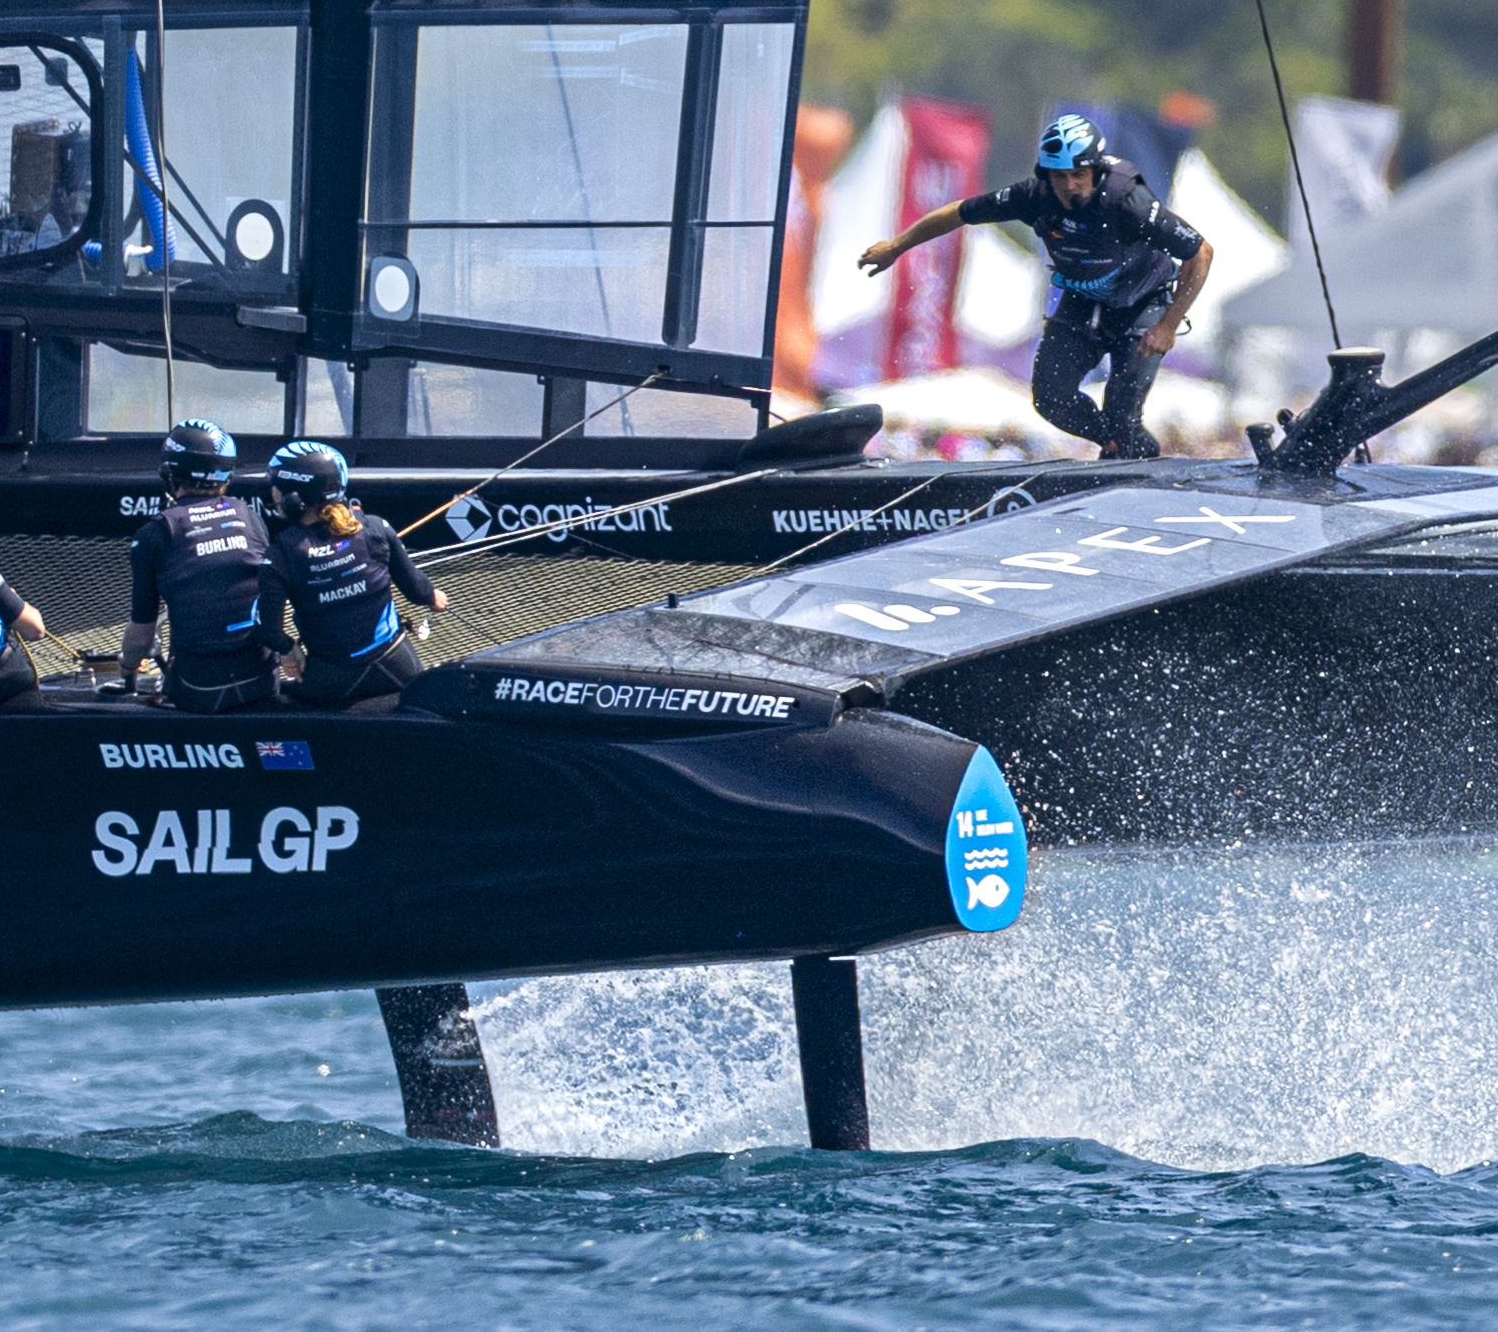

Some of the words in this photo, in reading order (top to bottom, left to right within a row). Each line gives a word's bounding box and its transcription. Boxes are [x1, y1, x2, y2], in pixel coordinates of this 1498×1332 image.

[497, 496, 673, 543] cognizant
[195, 535, 249, 557] BURLING
[308, 544, 336, 558] NZL
[928, 506, 1298, 606] APEX
[319, 580, 367, 604] MACKAY
[495, 677, 794, 719] #RACEFORTHEFUTURE
[98, 743, 245, 769] BURLING
[955, 810, 975, 839] 14
